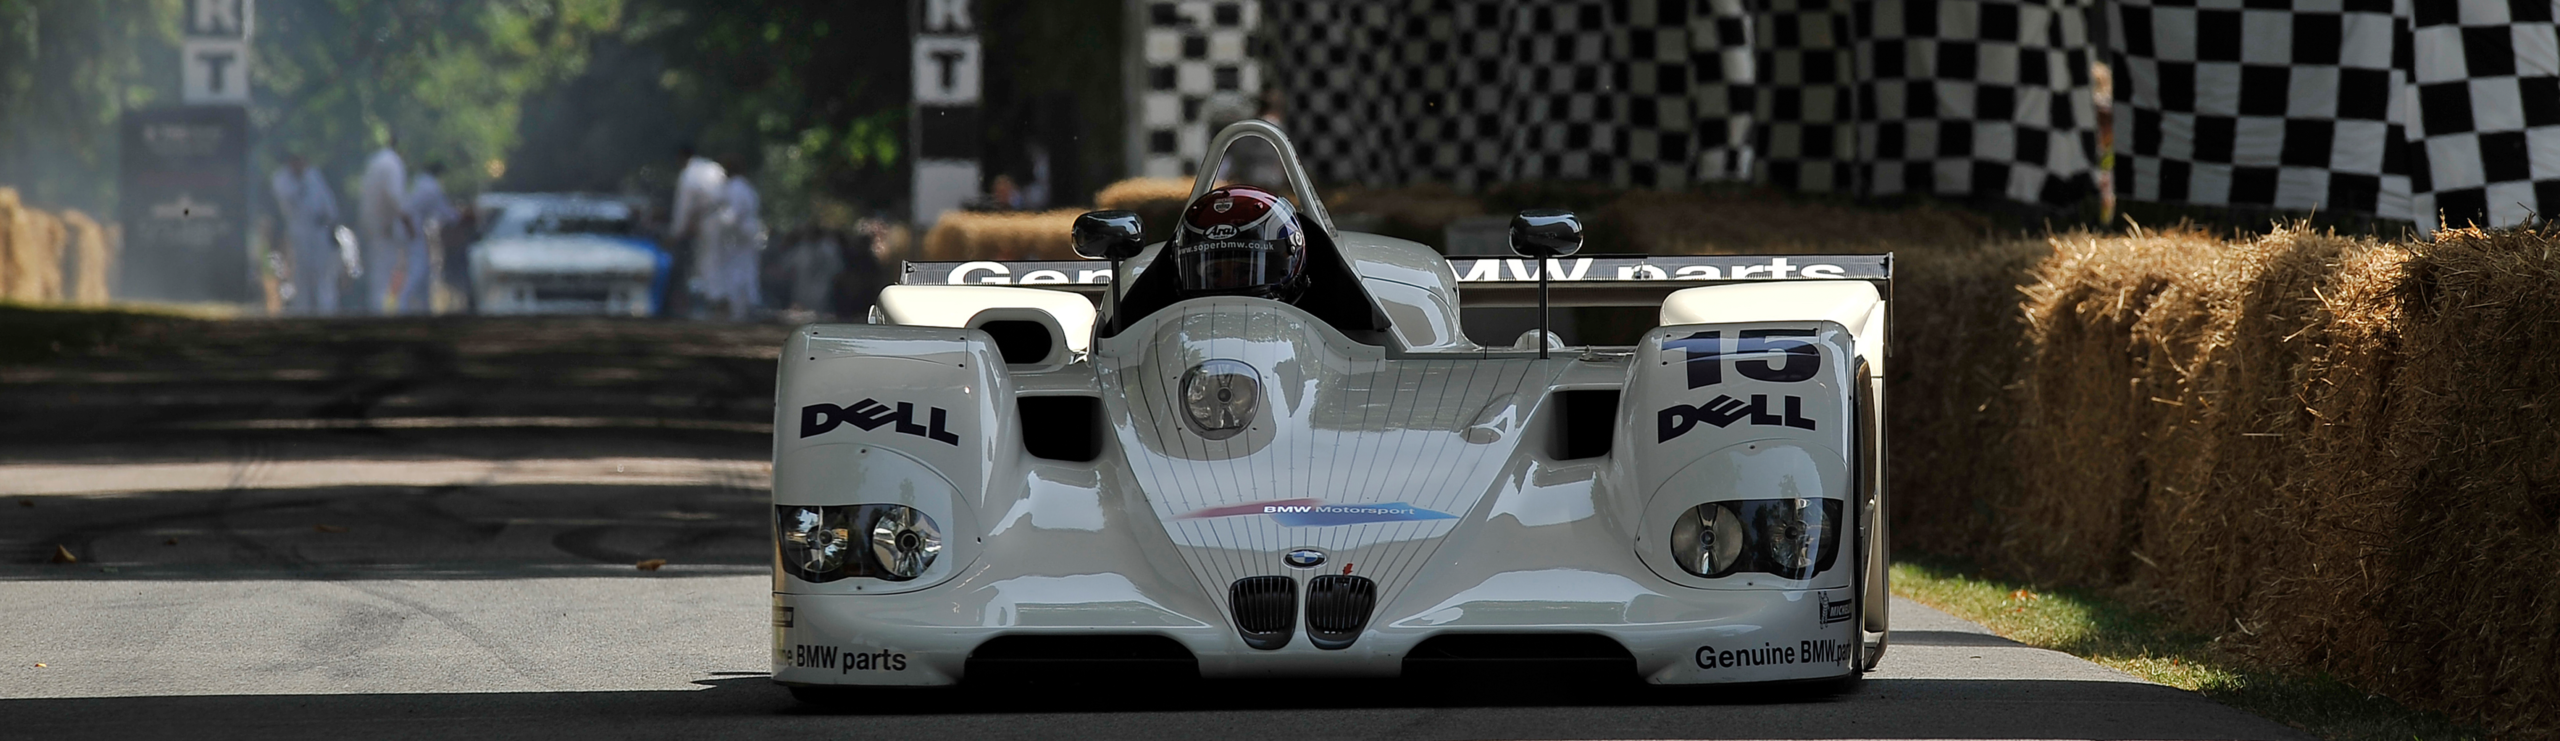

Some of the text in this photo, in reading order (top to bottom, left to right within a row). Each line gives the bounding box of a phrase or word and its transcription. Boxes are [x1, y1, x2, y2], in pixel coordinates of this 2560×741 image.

[1206, 225, 1235, 236] Arai
[1661, 329, 1821, 390] 15
[800, 398, 959, 446] DELL
[1658, 394, 1816, 444] DELL
[1315, 506, 1416, 515] Motorsport
[797, 644, 838, 668] BMW
[843, 649, 907, 674] parts
[1695, 642, 1795, 669] Genuine
[1801, 639, 1836, 663] BMW
